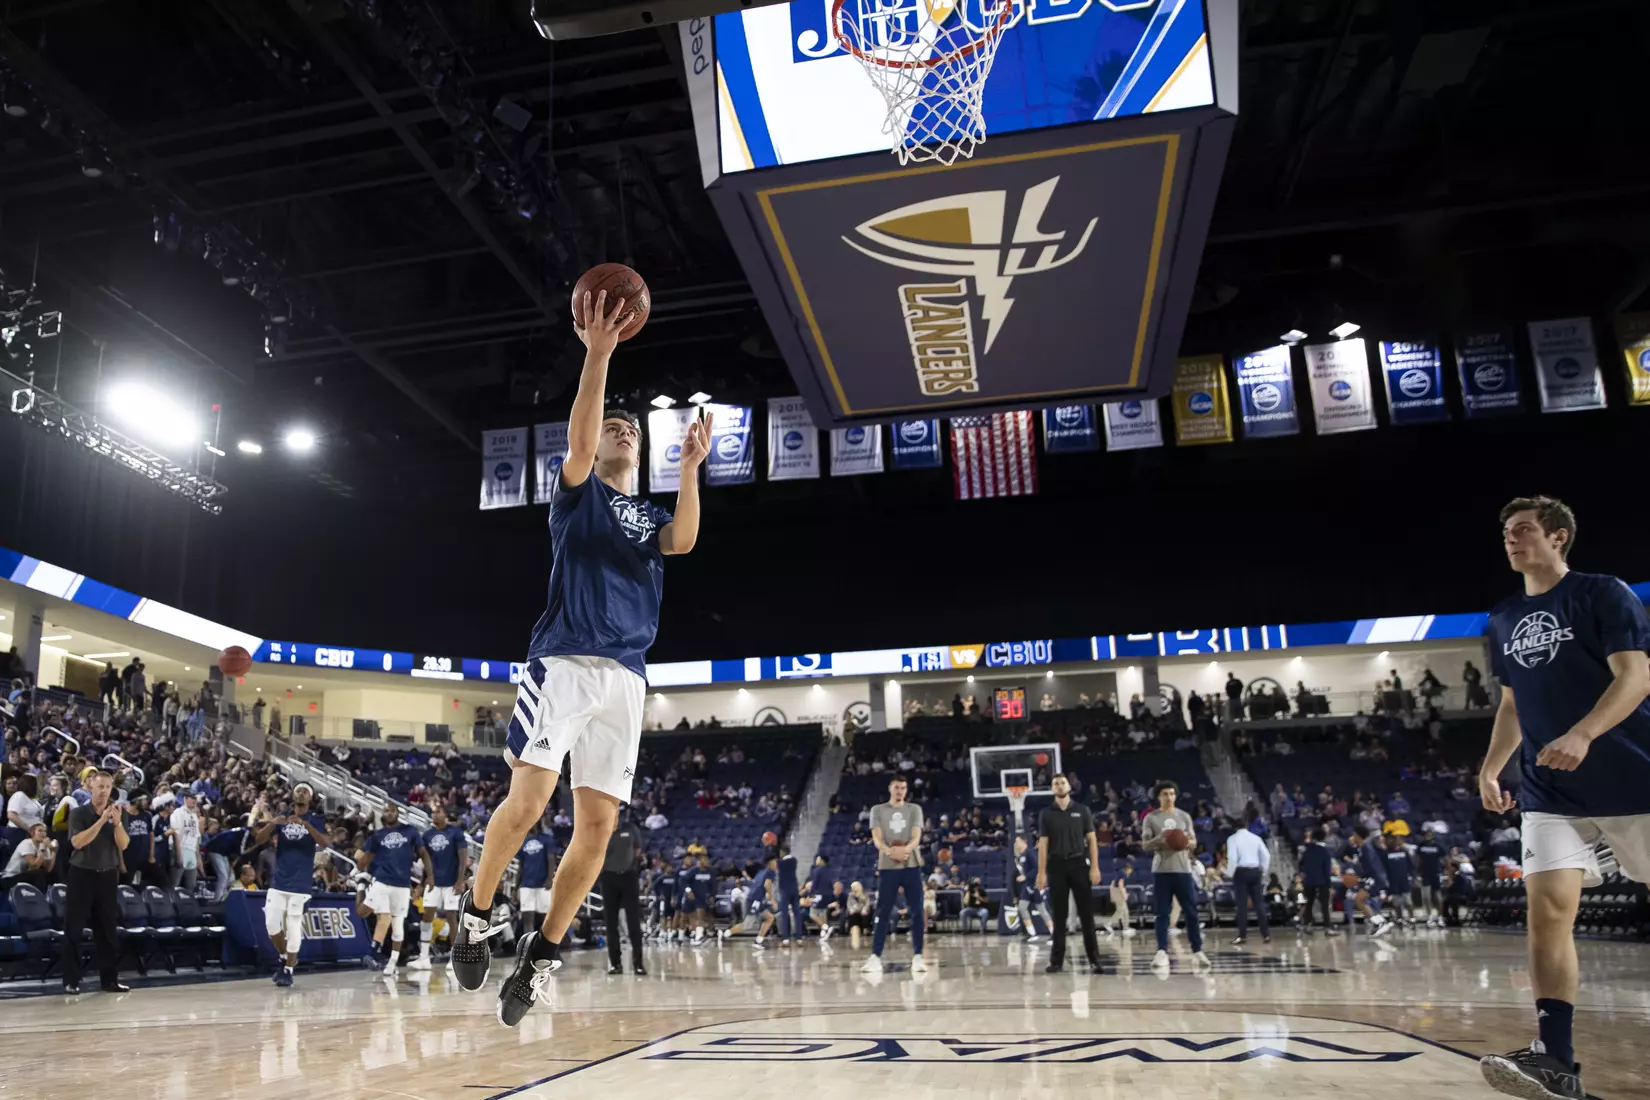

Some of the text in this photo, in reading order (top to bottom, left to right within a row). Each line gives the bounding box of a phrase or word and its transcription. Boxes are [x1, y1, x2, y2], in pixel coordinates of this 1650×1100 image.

[897, 277, 980, 397] LANCERS
[985, 640, 1053, 667] CBU
[1503, 627, 1575, 656] LANCERS
[315, 647, 393, 671] CBU 0
[952, 650, 977, 665] VS
[481, 661, 490, 679] 0
[1001, 700, 1022, 719] 30
[534, 743, 551, 751] adidas
[301, 907, 356, 940] NCERS
